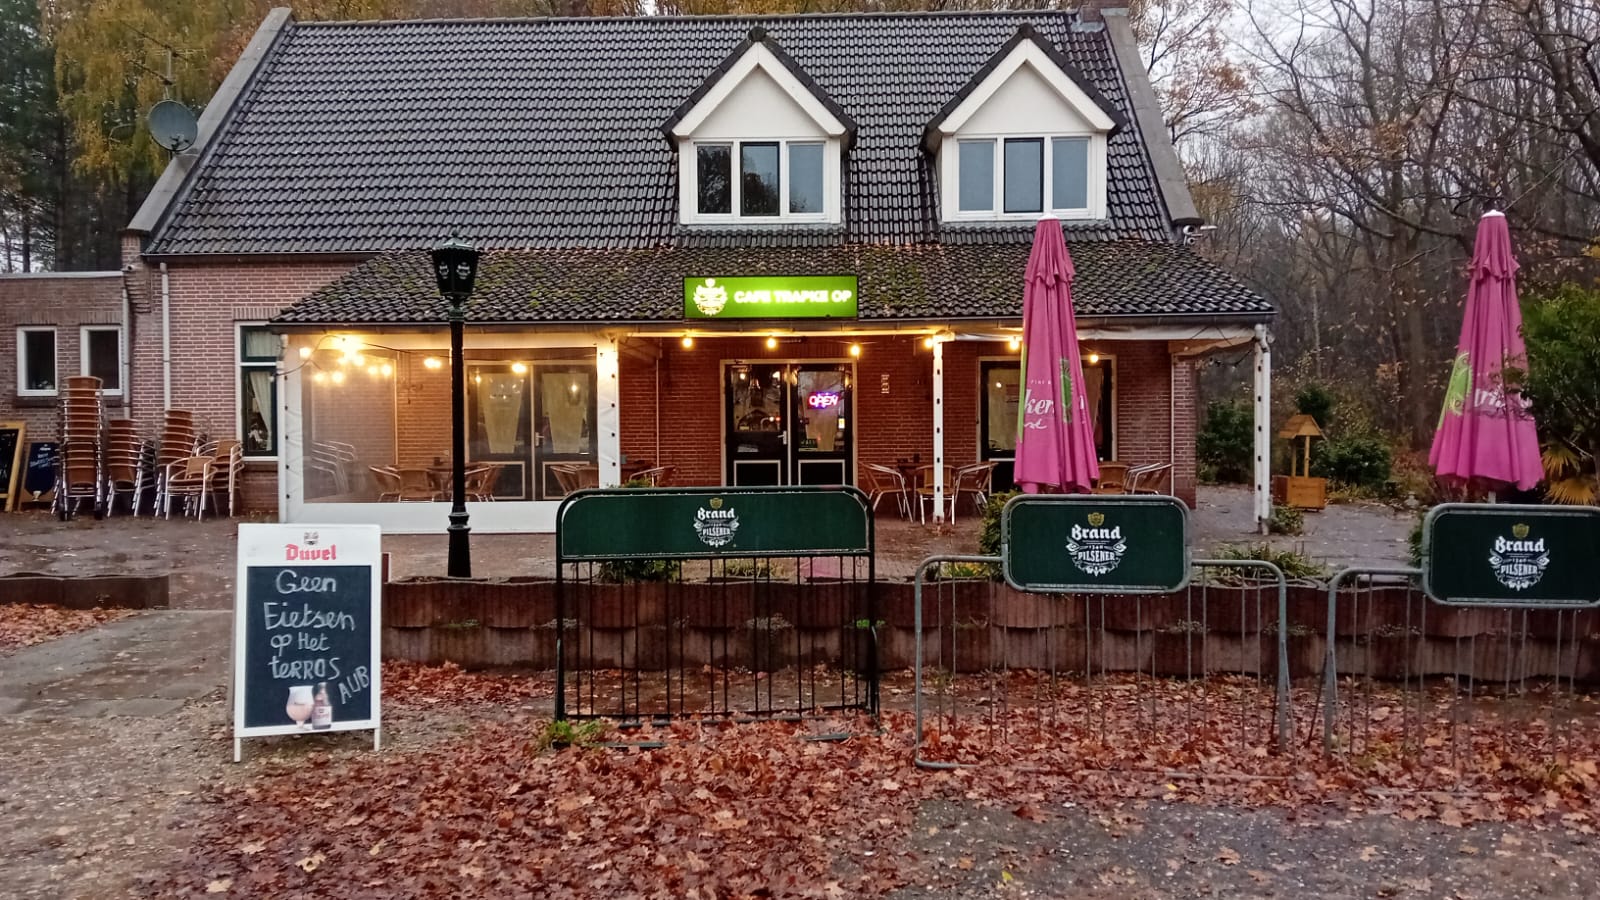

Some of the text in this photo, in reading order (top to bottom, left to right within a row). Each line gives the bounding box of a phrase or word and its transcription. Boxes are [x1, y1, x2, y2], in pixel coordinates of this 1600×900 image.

[831, 290, 853, 303] OP
[808, 393, 839, 408] OPEN
[697, 506, 735, 520] Brand
[1071, 523, 1121, 541] Brand
[285, 543, 337, 561] Duvel
[1495, 535, 1545, 553] Brand
[1077, 550, 1116, 562] PILSENER
[1500, 563, 1538, 576] PILSENER
[275, 569, 337, 594] Geen
[270, 631, 330, 657] op Het
[337, 666, 370, 704] AUB
